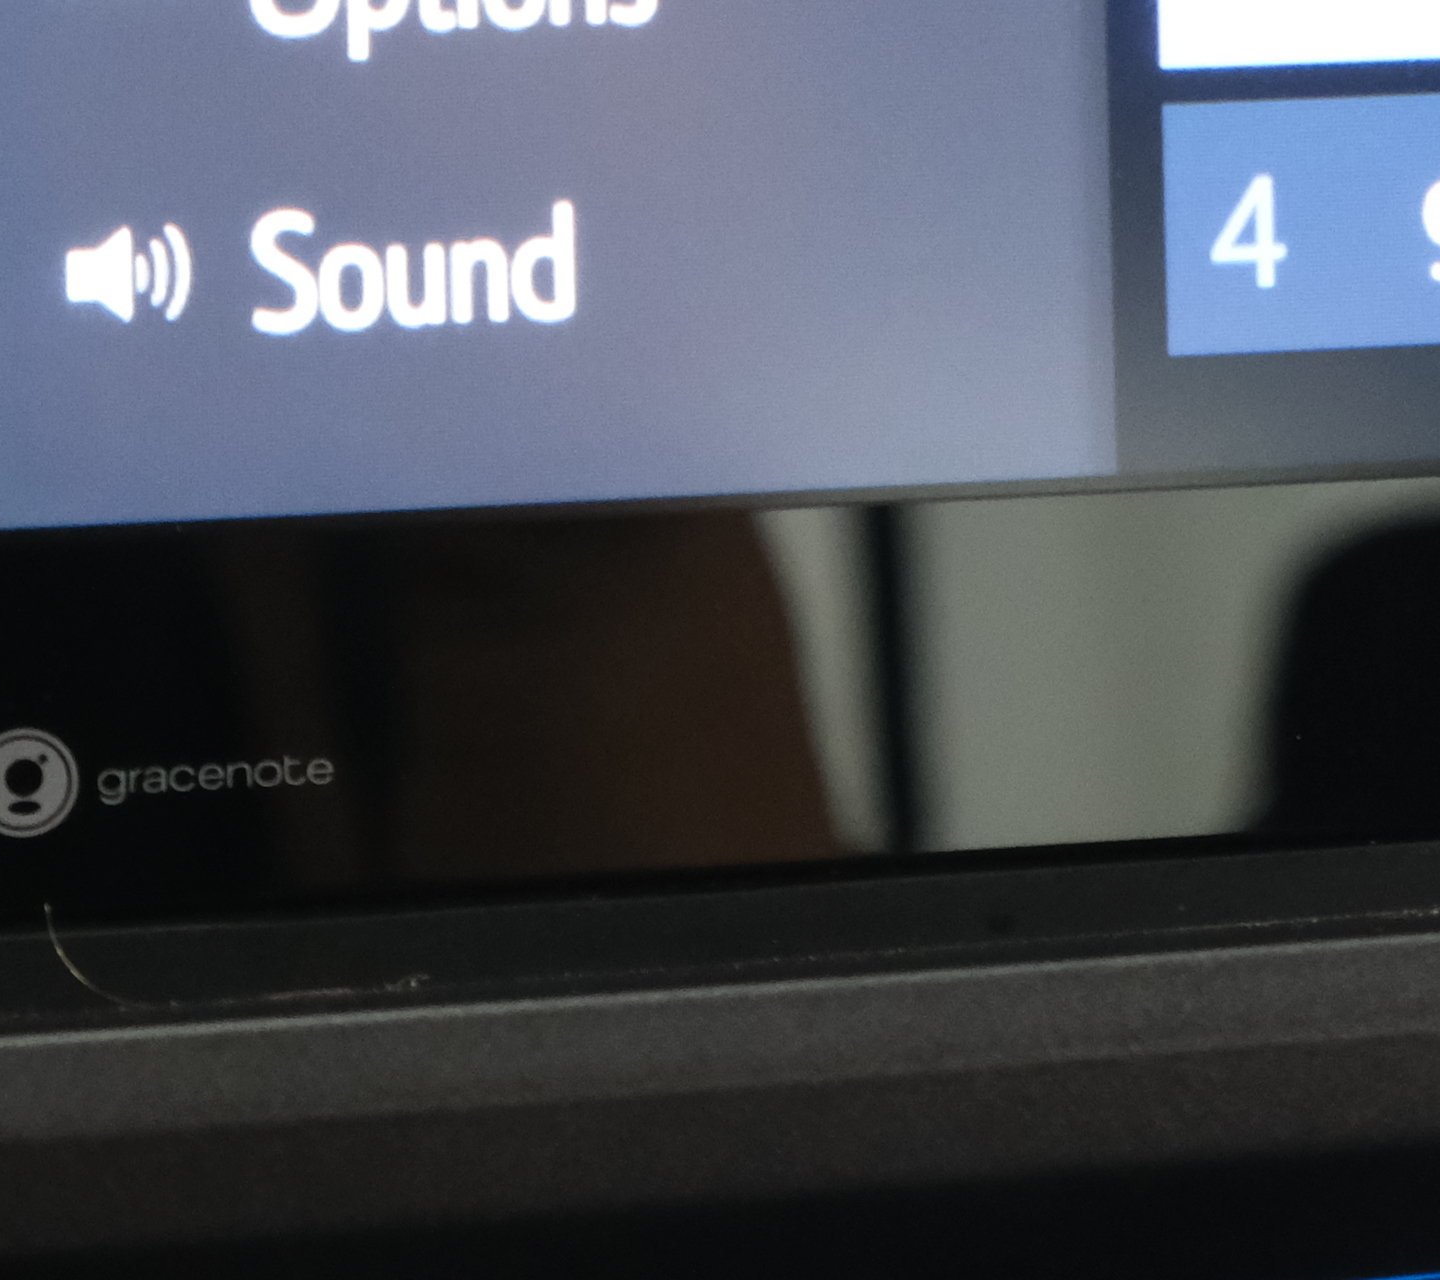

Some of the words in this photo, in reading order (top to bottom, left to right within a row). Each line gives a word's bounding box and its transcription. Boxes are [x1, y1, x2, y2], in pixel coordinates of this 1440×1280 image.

[249, 198, 578, 336] Sound
[1209, 172, 1289, 289] 4
[96, 753, 336, 807] gracenote
